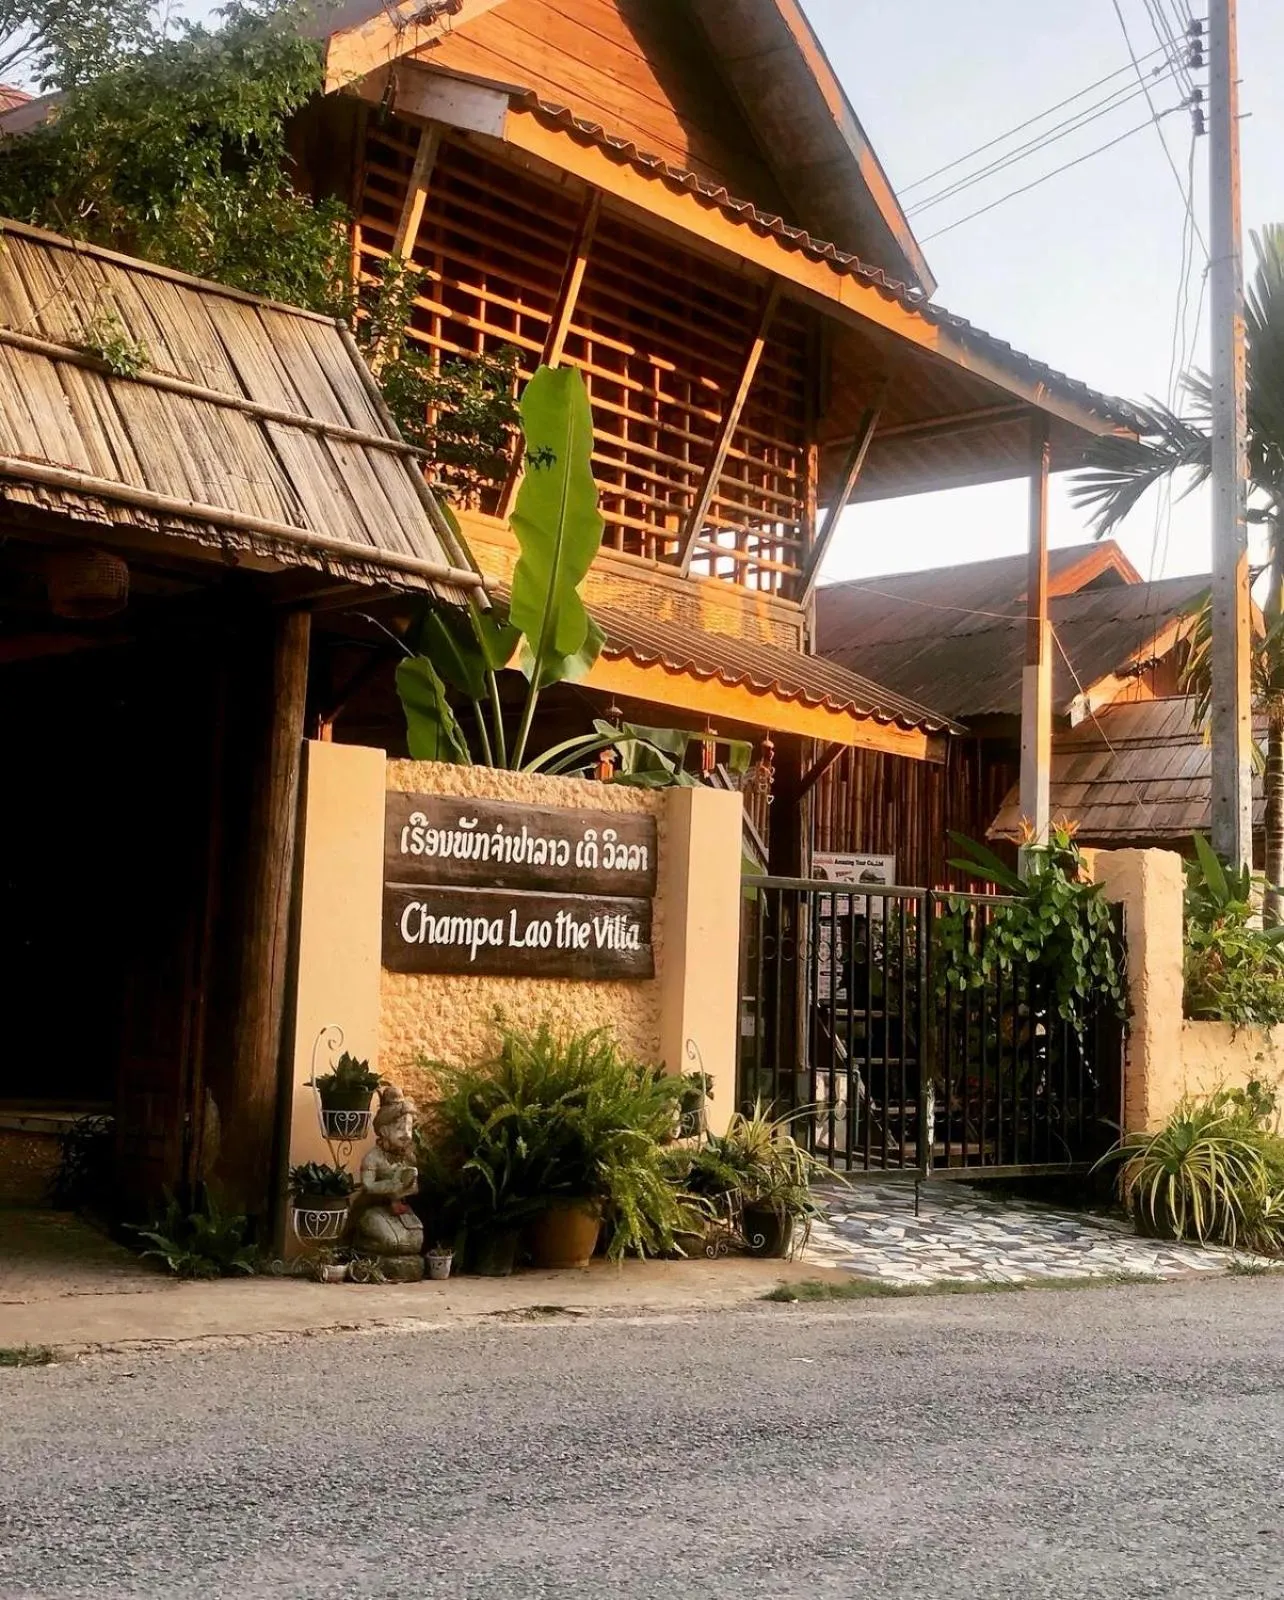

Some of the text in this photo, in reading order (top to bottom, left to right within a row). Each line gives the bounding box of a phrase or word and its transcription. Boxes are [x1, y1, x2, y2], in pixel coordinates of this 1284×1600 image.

[401, 901, 641, 962] Champa Lao the Villa
